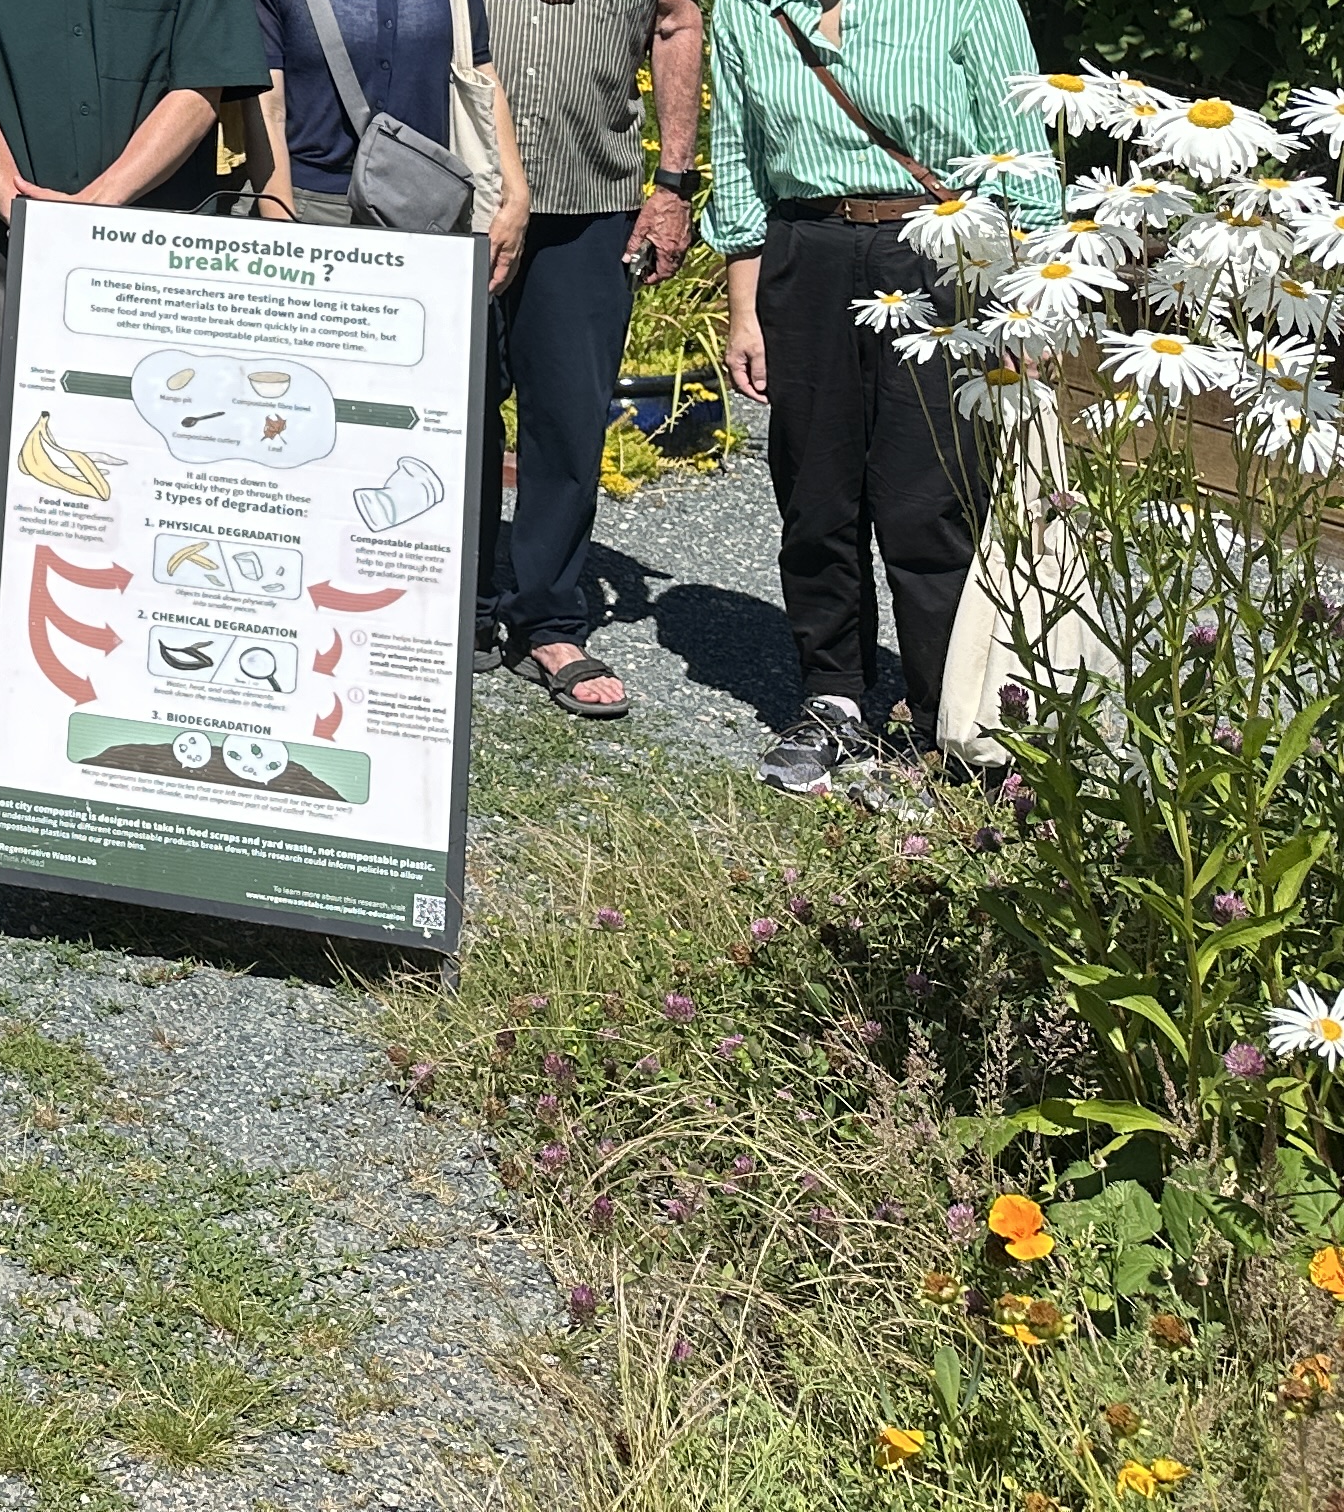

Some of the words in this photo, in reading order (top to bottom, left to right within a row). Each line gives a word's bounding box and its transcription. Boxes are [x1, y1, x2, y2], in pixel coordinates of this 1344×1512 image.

[91, 225, 136, 243] How
[141, 229, 166, 246] do
[172, 236, 304, 258] compostable
[310, 247, 404, 267] products
[168, 250, 238, 271] break
[247, 257, 315, 285] down
[322, 263, 334, 282] ?
[90, 277, 101, 287] In
[103, 279, 132, 290] these
[162, 286, 225, 299] researchers
[227, 292, 245, 301] are
[247, 293, 285, 307] testing
[287, 296, 311, 307] how
[313, 298, 337, 312] long
[339, 300, 348, 311] it
[350, 302, 380, 313] takes
[382, 304, 399, 315] for
[115, 293, 161, 305] different
[164, 299, 214, 311] materials
[216, 303, 228, 312] to
[230, 303, 261, 315] break
[263, 307, 294, 318] down
[296, 311, 318, 321] and
[90, 304, 115, 314] Some
[116, 306, 137, 316] food
[139, 310, 157, 318] and
[157, 312, 178, 320] yard
[180, 314, 207, 323] waste
[208, 315, 234, 325] break
[236, 318, 262, 328] down
[263, 322, 298, 333] quickly
[299, 324, 309, 333] in
[317, 328, 358, 338] compost
[380, 332, 396, 341] but
[116, 320, 140, 329] other
[175, 324, 192, 334] like
[193, 329, 252, 340] compostable
[293, 337, 314, 347] take
[315, 341, 341, 349] more
[153, 477, 173, 487] how
[174, 481, 208, 493] quickly
[209, 484, 231, 496] they
[232, 488, 244, 497] go
[245, 488, 283, 501] through
[285, 493, 311, 503] these
[186, 471, 194, 479] It
[195, 472, 207, 481] all
[208, 475, 238, 484] comes
[239, 477, 266, 487] down
[267, 480, 278, 489] to
[38, 496, 61, 506] Food
[62, 501, 89, 510] waste
[154, 489, 162, 500] 3
[165, 491, 202, 505] types
[204, 495, 219, 507] of
[158, 519, 214, 534] PHYSICAL
[217, 526, 300, 544] DEGRADATION
[350, 534, 412, 548] Compostable
[414, 541, 451, 553] plastics
[151, 611, 210, 627] CHEMICAL
[213, 619, 297, 638] DEGRADATION
[166, 712, 271, 735] BIODEGRADATION
[1, 811, 58, 827] understanding
[58, 818, 76, 828] how
[76, 821, 111, 834] different
[111, 828, 162, 842] compostable
[163, 836, 199, 848] products
[200, 840, 223, 851] break
[250, 848, 267, 858] this
[267, 852, 303, 863] research
[303, 857, 327, 866] could
[327, 859, 355, 871] inform
[356, 864, 389, 876] policies
[389, 868, 399, 877] to
[399, 870, 423, 880] allow
[14, 800, 32, 812] city
[33, 805, 87, 821] composting
[87, 810, 97, 821] is
[97, 813, 140, 828] designed
[141, 820, 152, 829] to
[152, 821, 174, 833] take
[175, 824, 185, 835] in
[186, 826, 208, 838] food
[209, 831, 240, 843] scraps
[241, 836, 260, 845] and
[261, 839, 283, 849] yard
[317, 847, 335, 857] not
[335, 850, 398, 866] compostable
[40, 827, 70, 839] plastics
[70, 831, 87, 841] into
[87, 835, 102, 844] our
[102, 838, 126, 847] green
[51, 851, 76, 862] Waste
[77, 855, 97, 866] Labs
